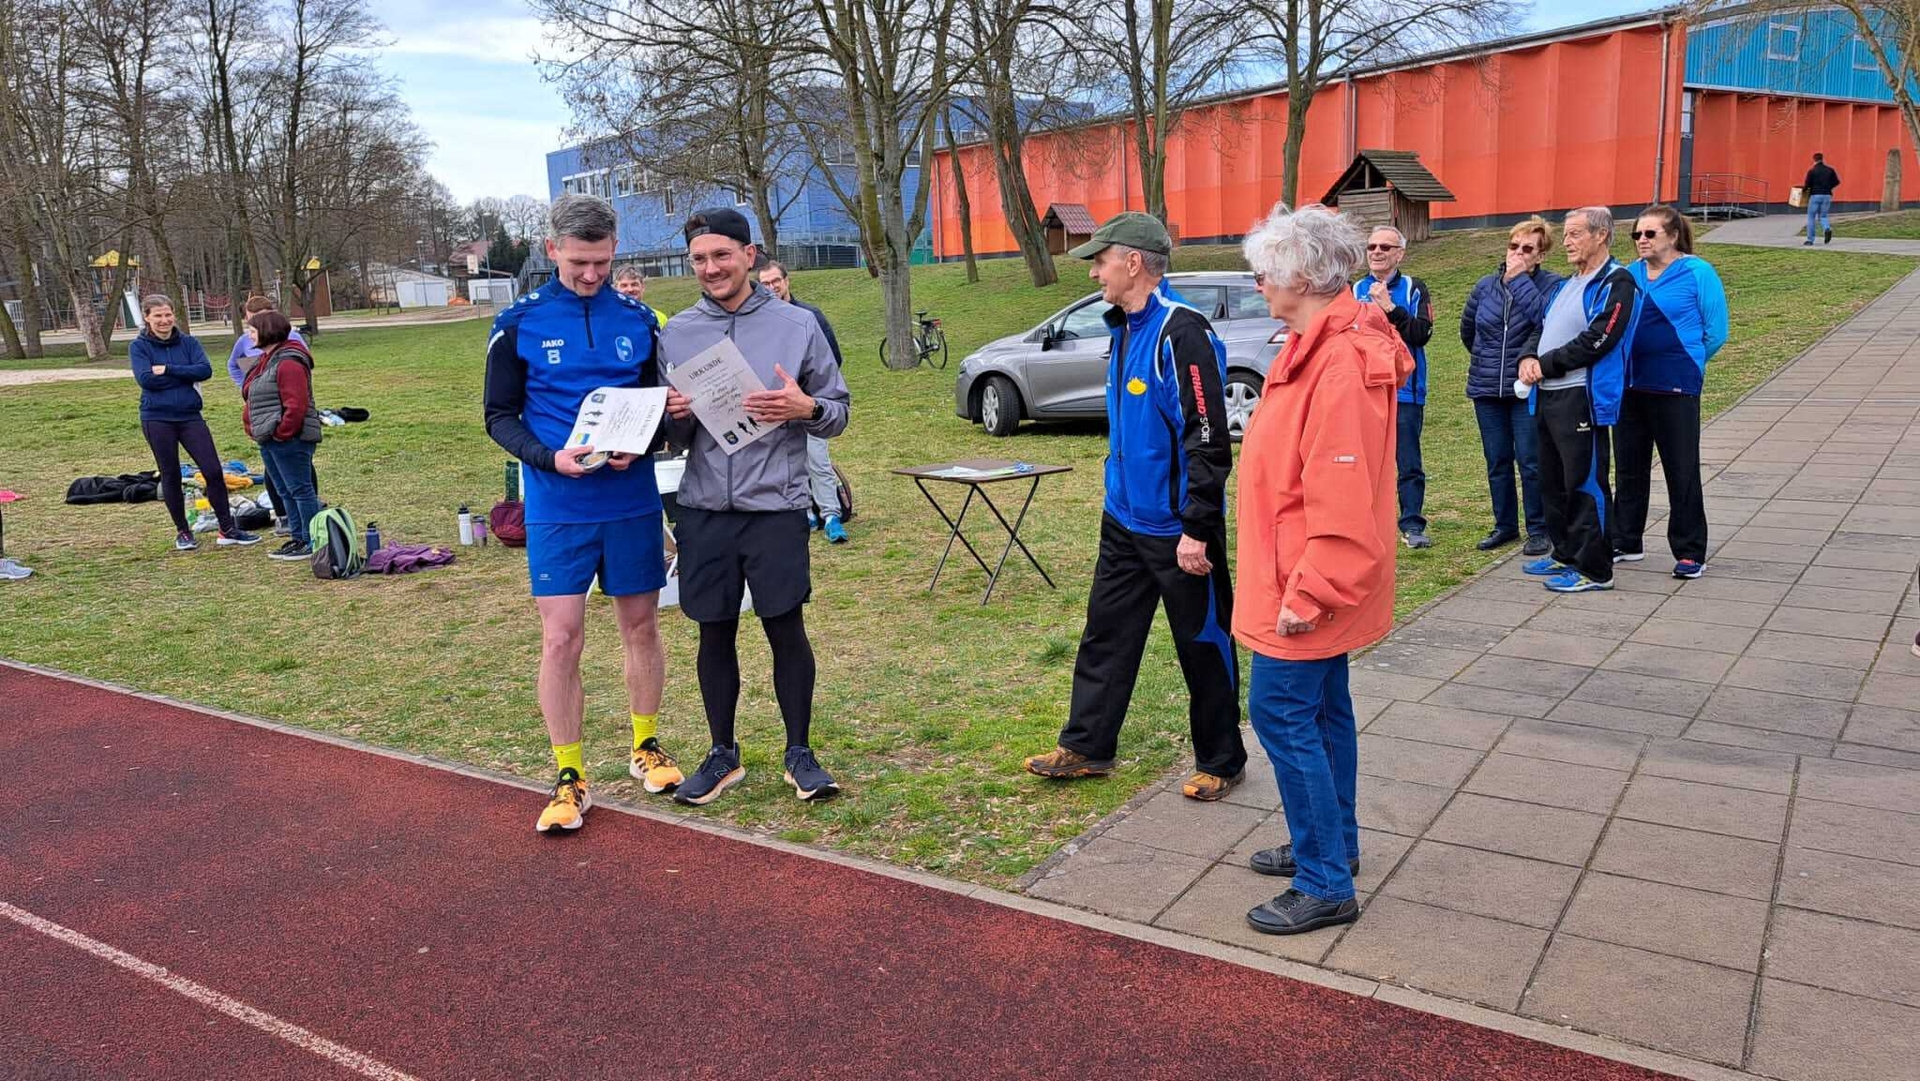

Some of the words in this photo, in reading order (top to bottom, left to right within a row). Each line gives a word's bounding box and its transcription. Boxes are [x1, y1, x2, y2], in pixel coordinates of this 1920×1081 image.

[541, 338, 564, 349] JAKO
[688, 356, 723, 380] URKUNDE
[1189, 364, 1207, 415] ERHARD
[1199, 416, 1210, 443] SPORT
